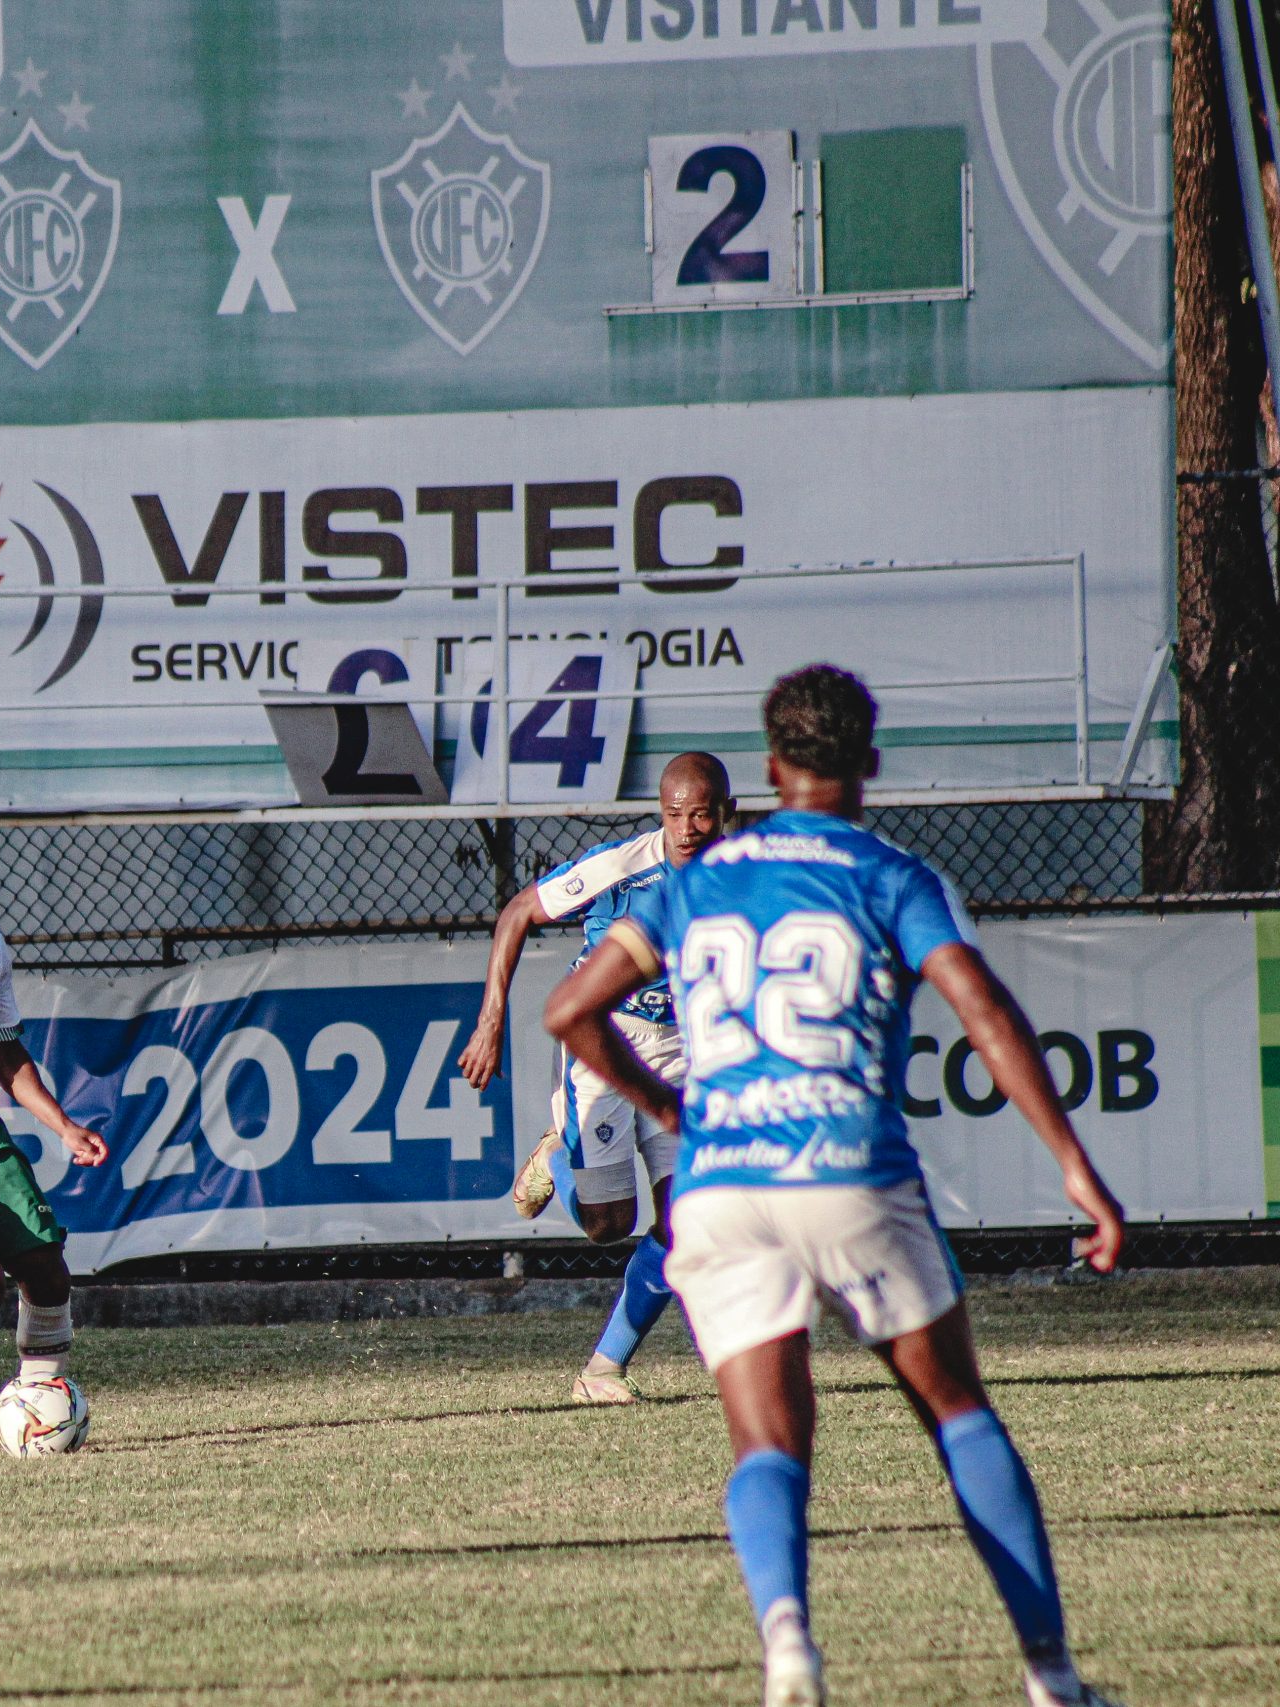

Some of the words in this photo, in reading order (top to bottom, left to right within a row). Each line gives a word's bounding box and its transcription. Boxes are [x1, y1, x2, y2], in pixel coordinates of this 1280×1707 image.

[216, 194, 297, 315] X
[675, 146, 770, 286] 2
[131, 476, 745, 608] VISTEC
[508, 655, 607, 789] 4
[681, 911, 863, 1080] 22
[121, 1019, 495, 1190] 2024
